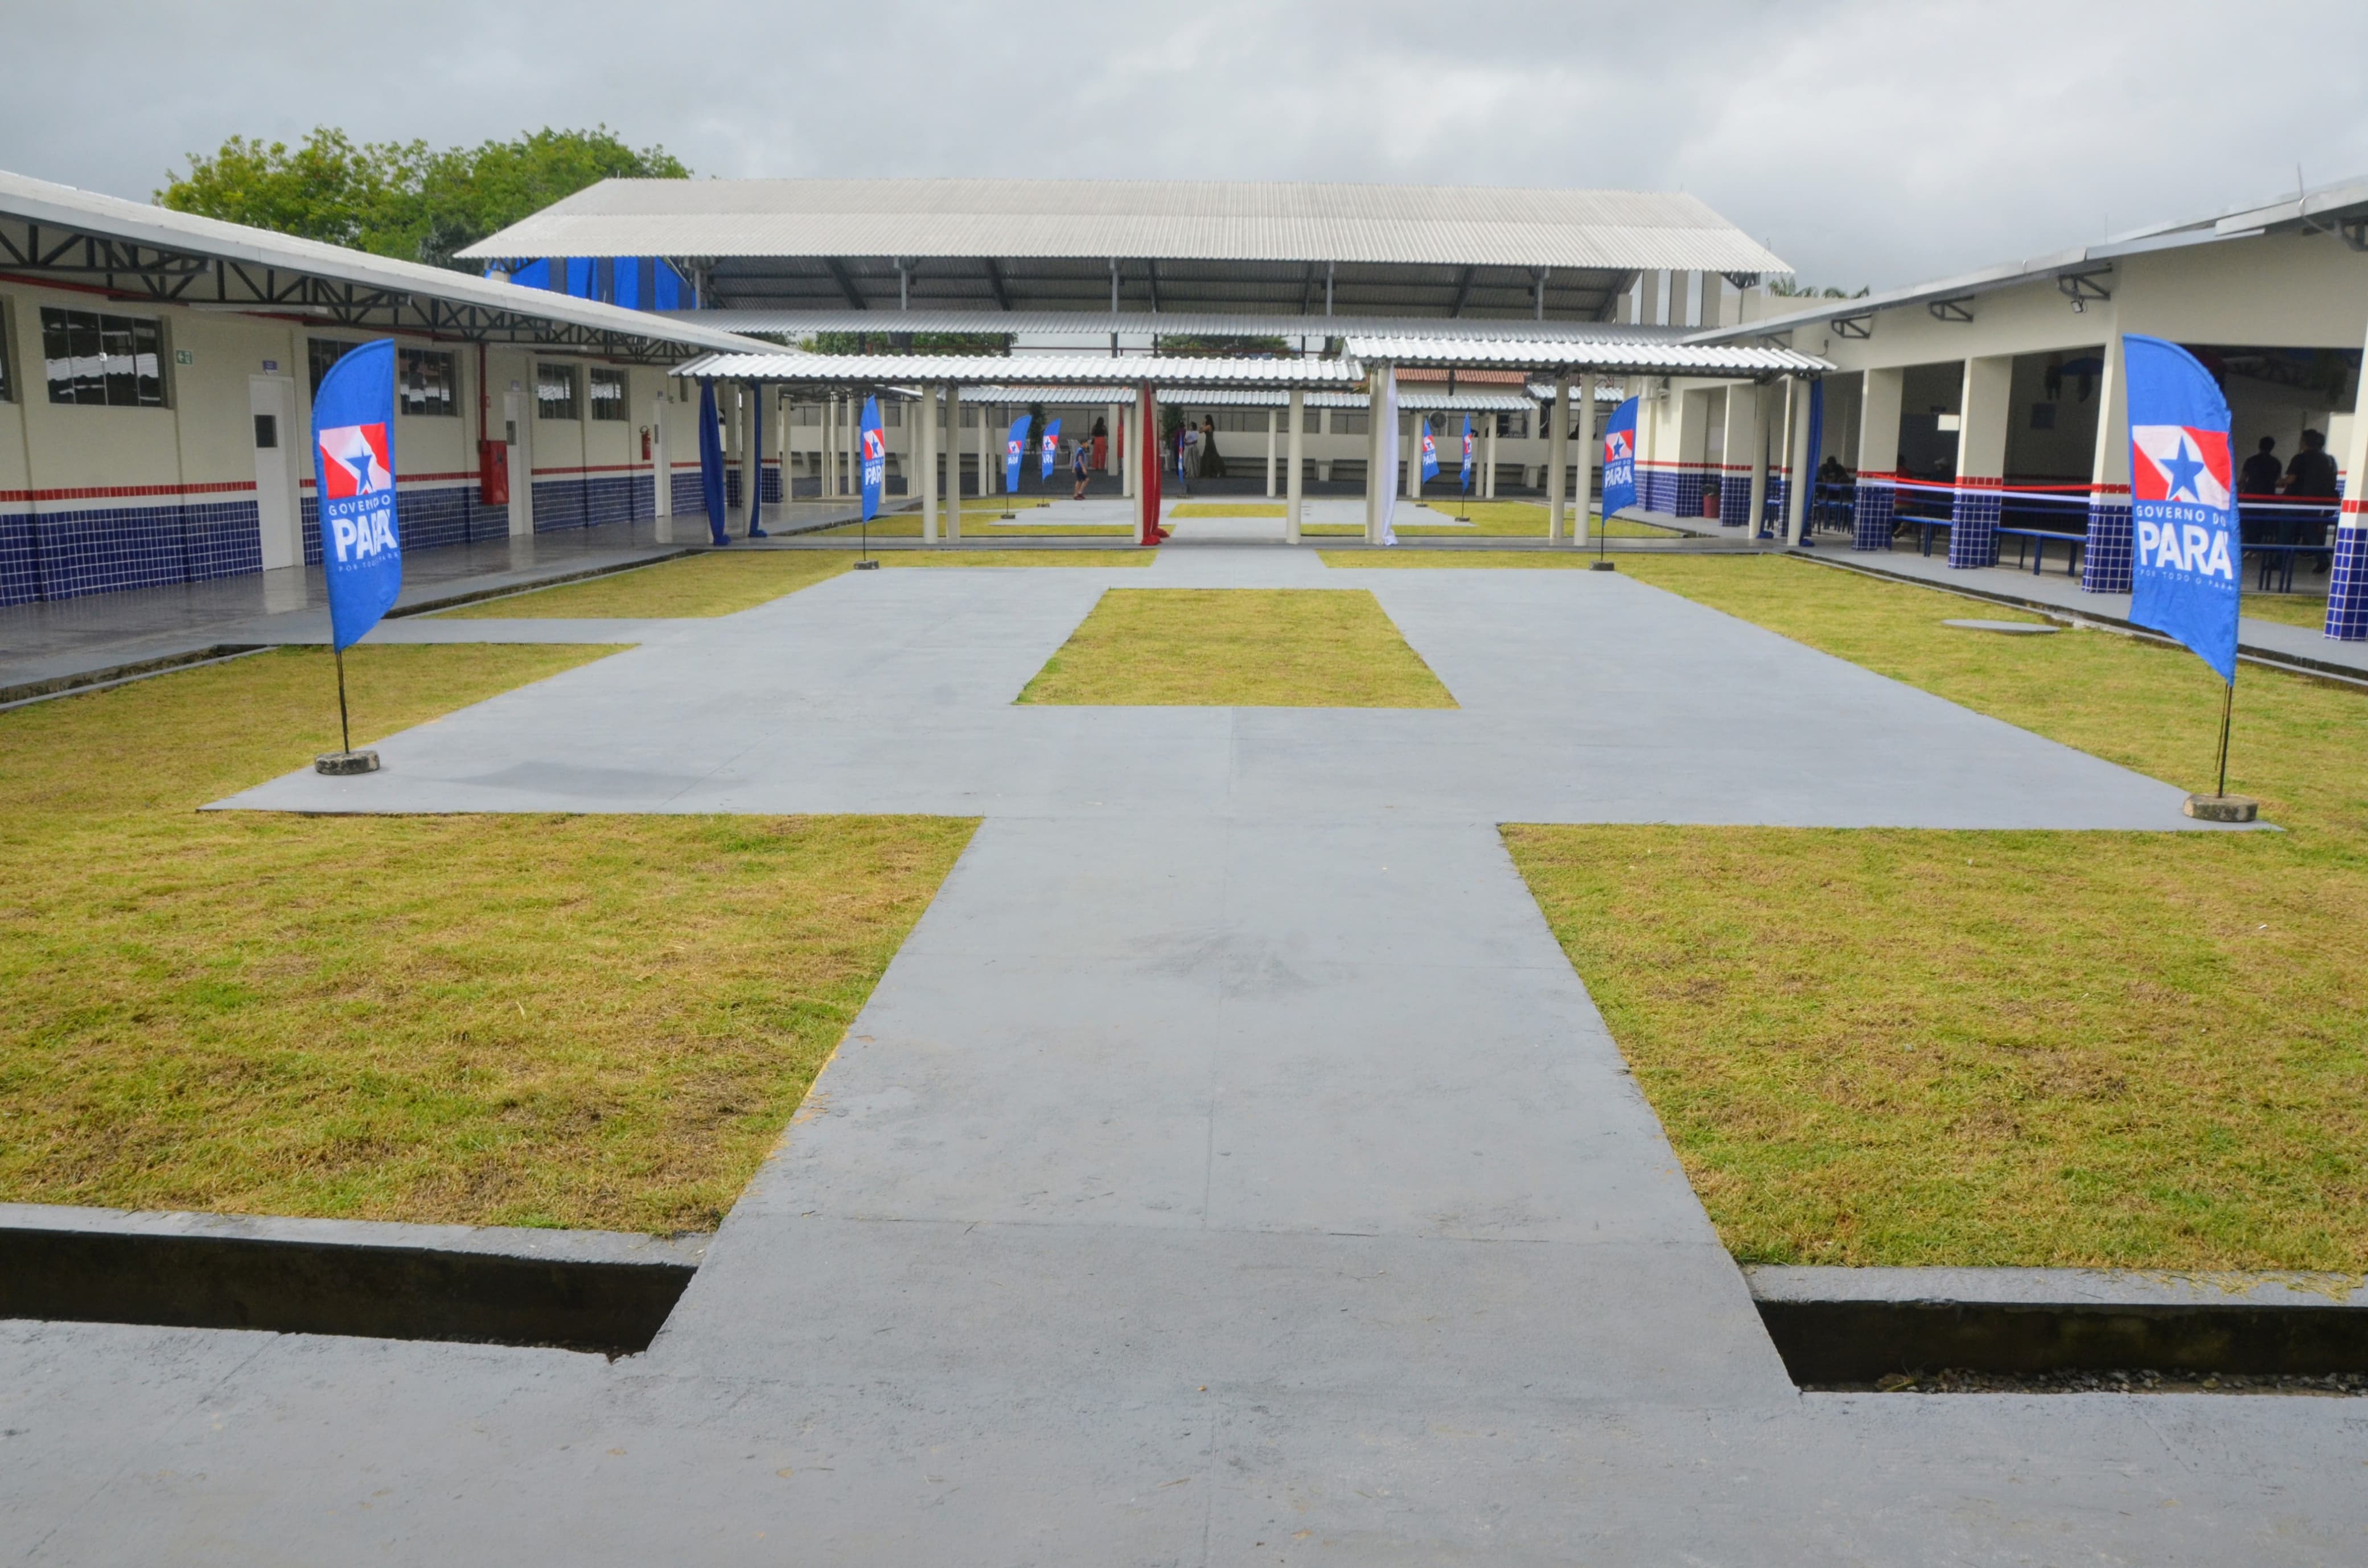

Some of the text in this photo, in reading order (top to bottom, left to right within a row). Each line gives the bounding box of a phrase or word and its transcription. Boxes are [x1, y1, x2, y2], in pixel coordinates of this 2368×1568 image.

[2136, 505, 2226, 527] GOVERNO DO
[2137, 521, 2233, 579] PARÁ
[2163, 571, 2190, 582] TODO
